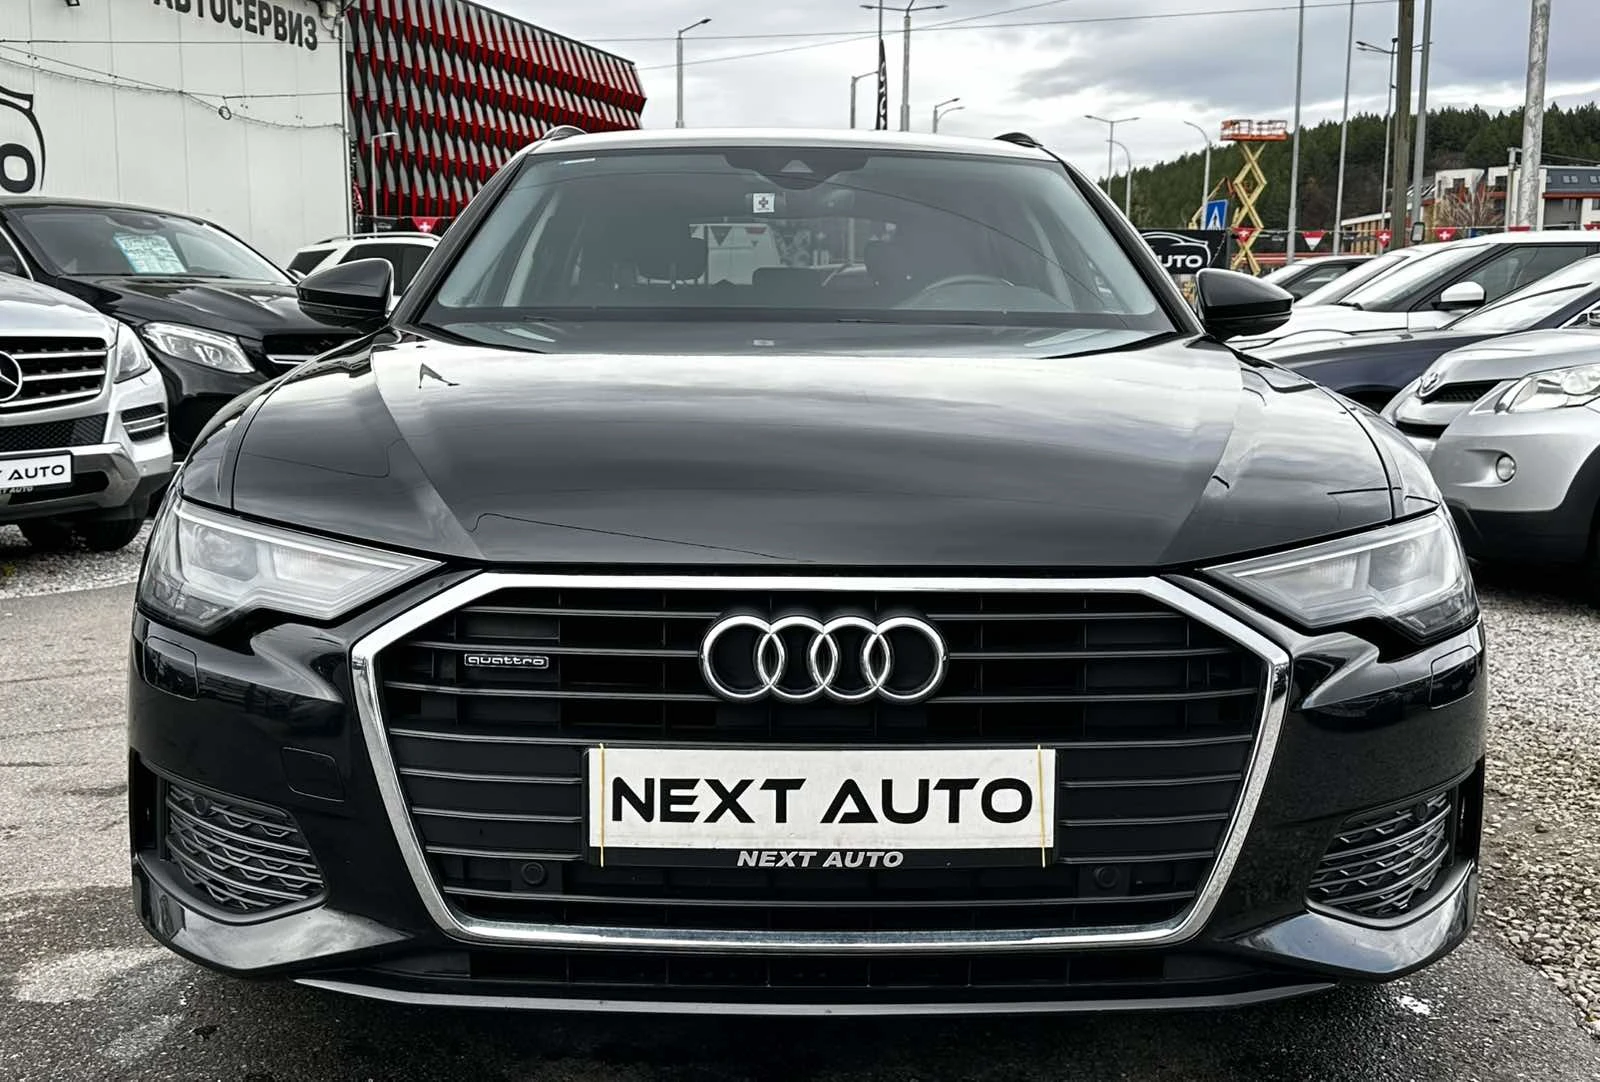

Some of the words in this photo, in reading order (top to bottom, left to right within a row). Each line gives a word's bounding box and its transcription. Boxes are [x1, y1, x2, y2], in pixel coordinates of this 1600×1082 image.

[153, 0, 318, 51] ОСЕРВИЗ
[8, 464, 65, 480] AUTO
[468, 656, 545, 665] quattro
[612, 777, 807, 824] NEXT
[820, 777, 1033, 825] AUTO
[737, 851, 817, 867] NEXT
[823, 851, 904, 868] AUTO
